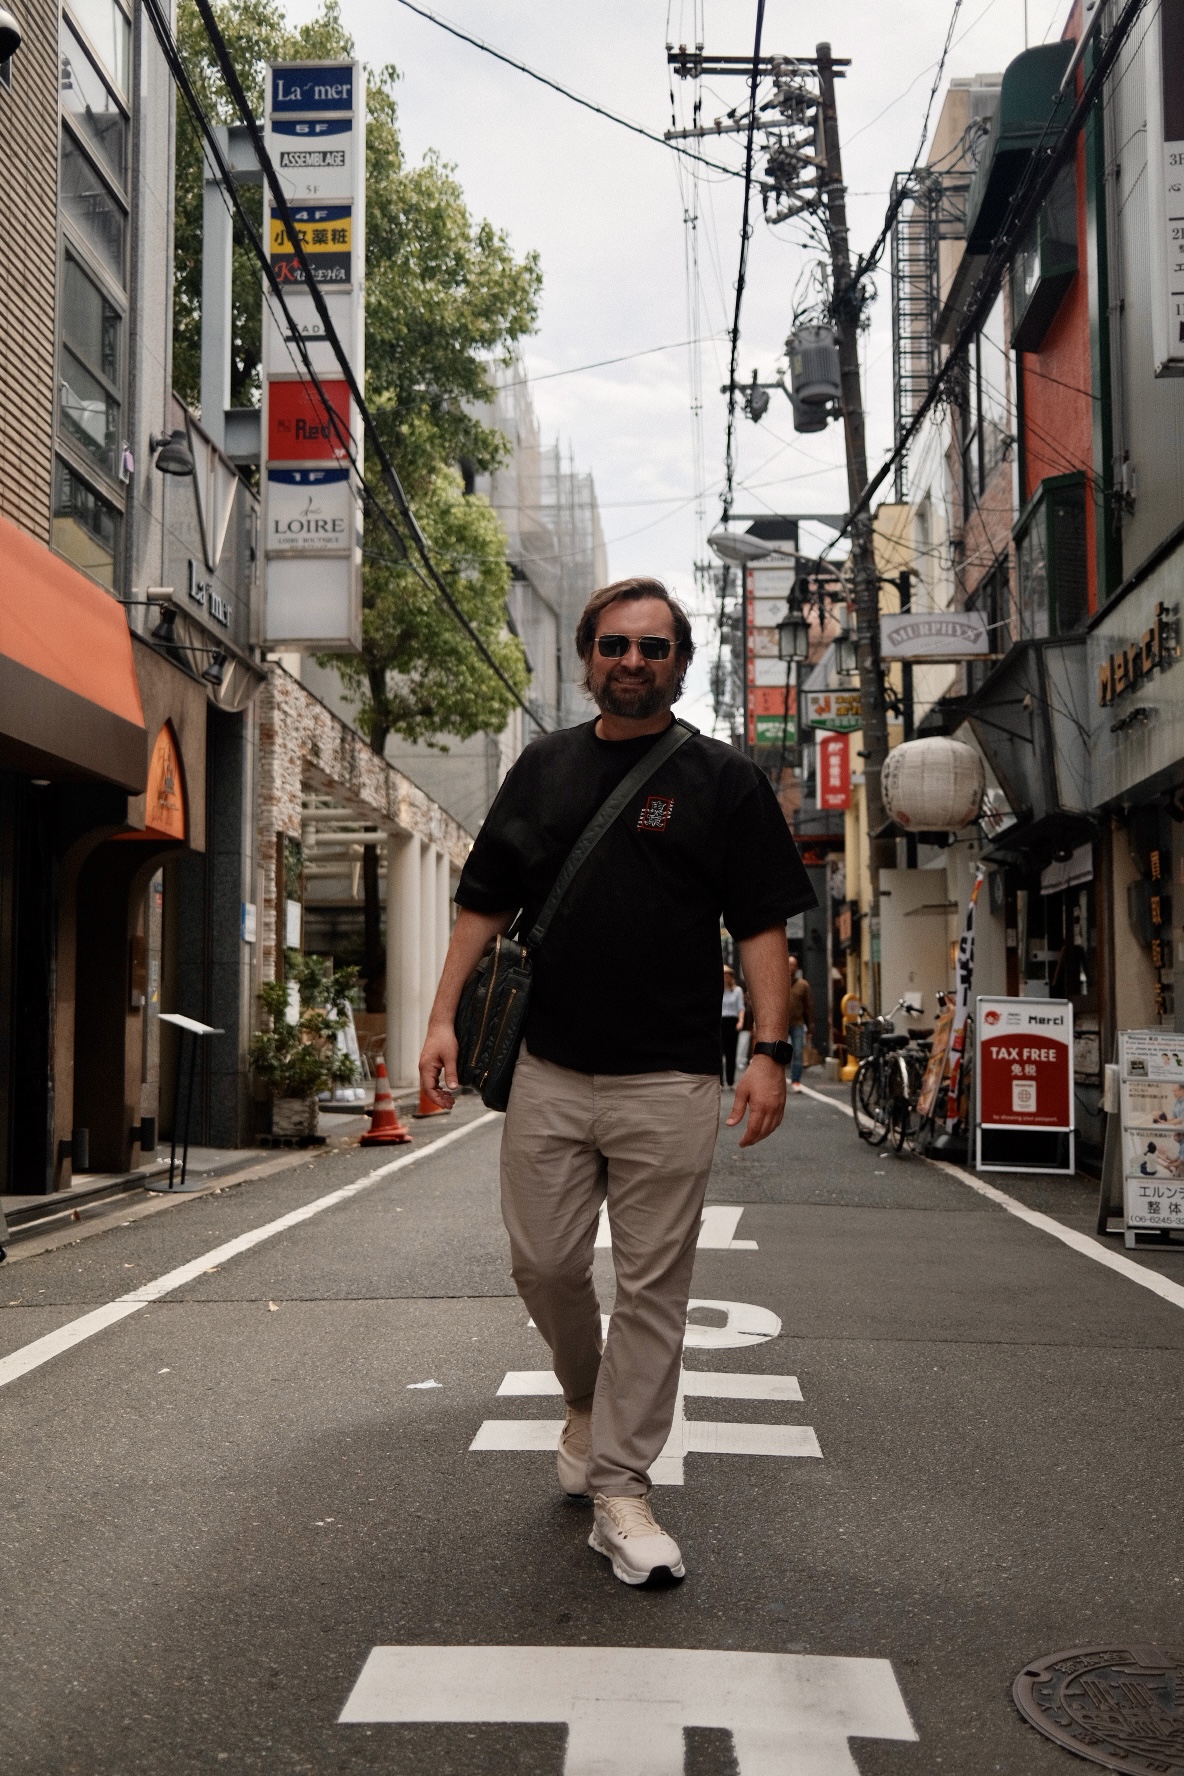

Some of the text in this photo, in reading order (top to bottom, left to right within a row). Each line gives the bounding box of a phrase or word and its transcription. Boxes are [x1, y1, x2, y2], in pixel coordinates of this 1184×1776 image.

[277, 80, 351, 100] La mer
[282, 152, 344, 166] ASSEMBLAGE
[274, 518, 344, 534] LOIRE
[1028, 1015, 1064, 1026] Merci
[990, 1047, 1057, 1062] TAX FREE
[1011, 1063, 1037, 1077] 免税
